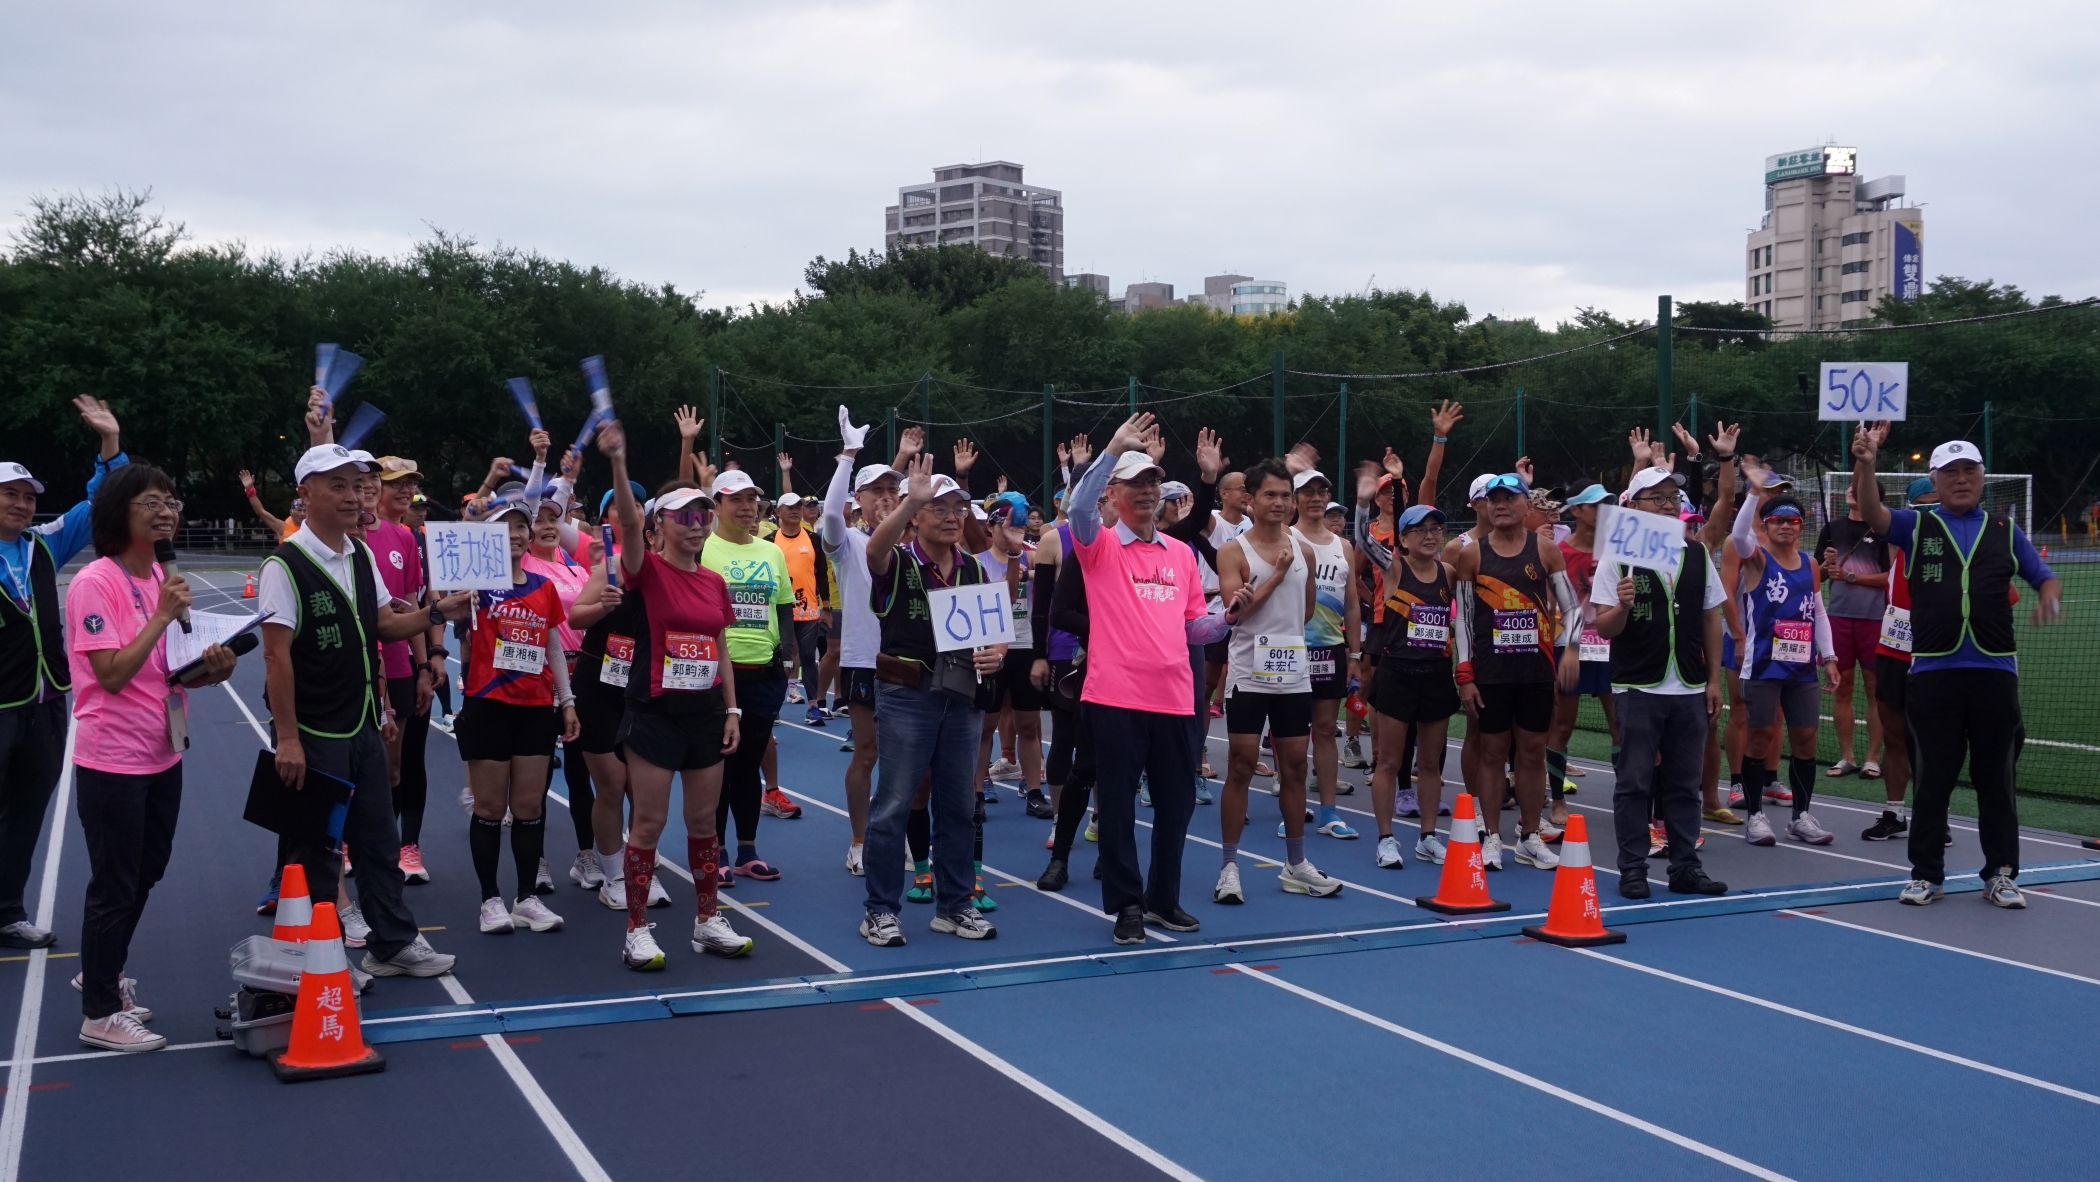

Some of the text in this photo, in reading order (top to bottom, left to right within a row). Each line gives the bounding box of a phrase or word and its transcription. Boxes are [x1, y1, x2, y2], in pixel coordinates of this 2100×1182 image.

[1827, 368, 1900, 413] 50K
[435, 529, 507, 582] 接力組
[1922, 537, 1944, 583] 裁判
[1161, 566, 1175, 581] 14
[1766, 571, 1789, 604] 苗
[735, 591, 766, 604] 6005
[309, 590, 343, 651] 裁判
[945, 592, 1005, 642] 6H
[1418, 612, 1446, 626] 3001
[1503, 617, 1535, 629] 4003
[1893, 619, 1912, 631] 502
[511, 628, 541, 645] 59-1
[1500, 633, 1533, 644] 吳建成
[1783, 628, 1810, 641] 5018
[502, 646, 539, 662] 唐湘梅
[679, 643, 711, 659] 53-1
[1269, 649, 1295, 660] 6012
[1264, 660, 1297, 672] 朱宏仁
[1468, 851, 1484, 891] 超馬
[1580, 877, 1598, 919] 超馬
[316, 986, 344, 1042] 超馬
